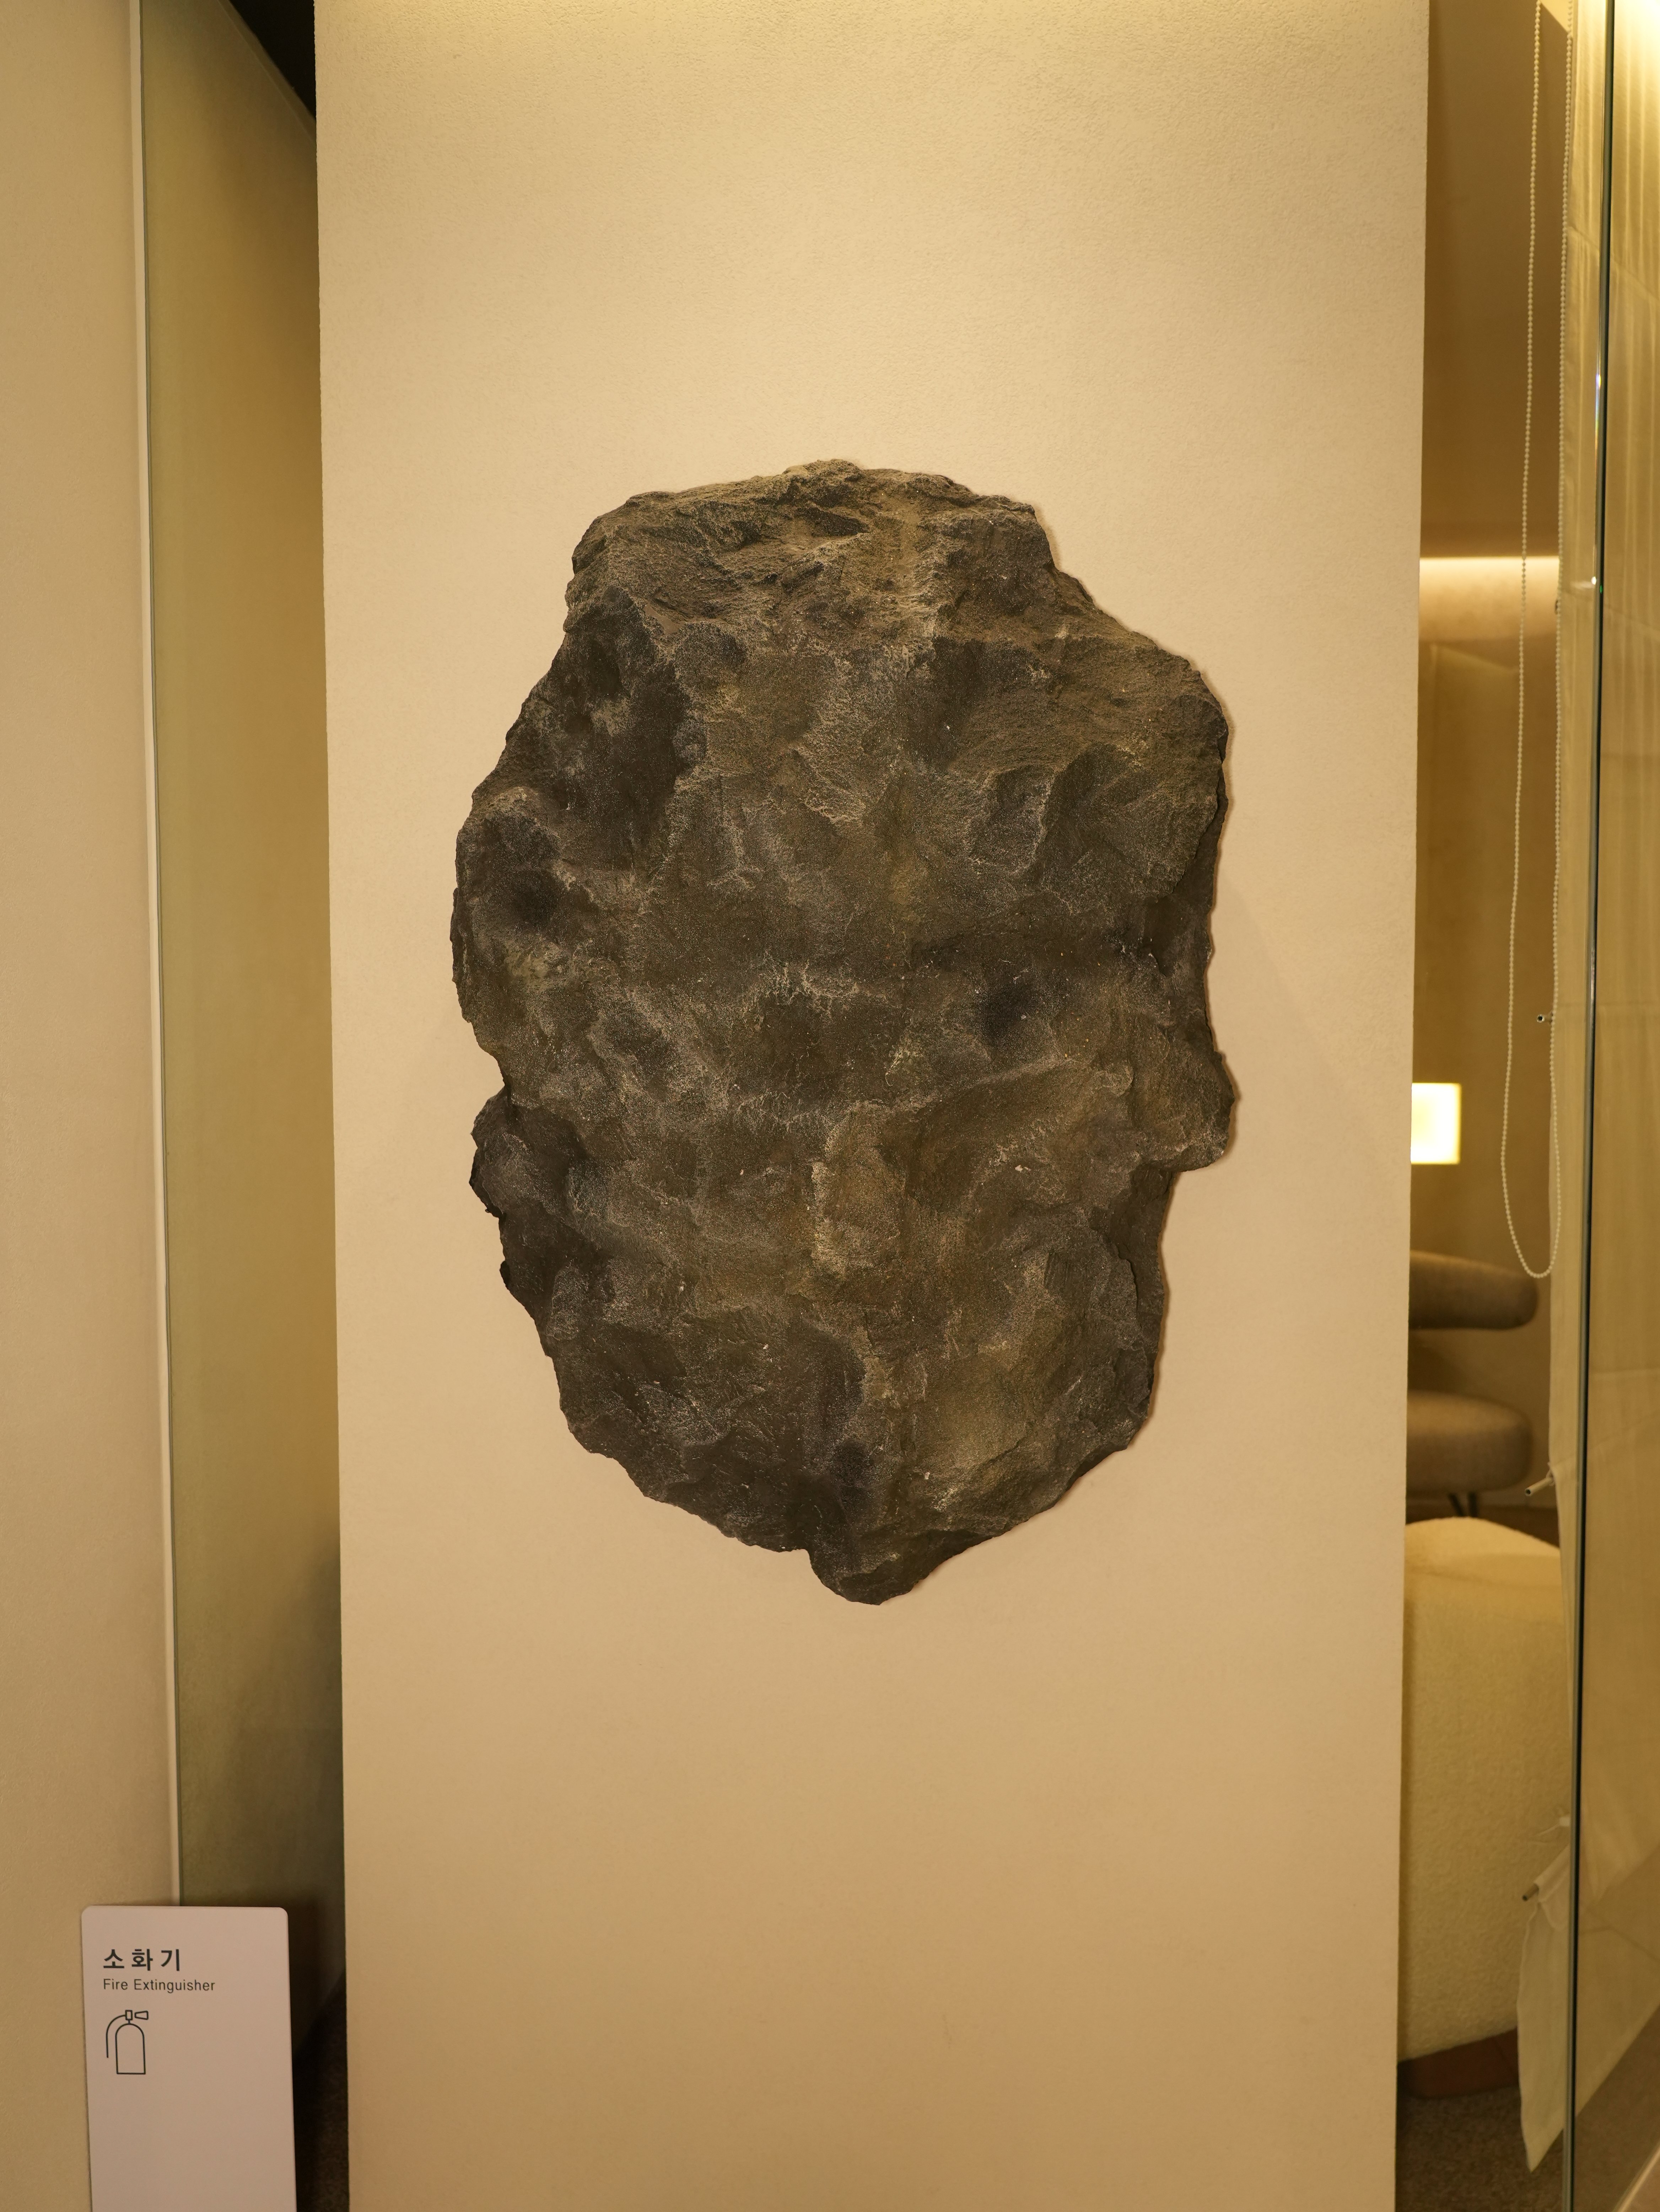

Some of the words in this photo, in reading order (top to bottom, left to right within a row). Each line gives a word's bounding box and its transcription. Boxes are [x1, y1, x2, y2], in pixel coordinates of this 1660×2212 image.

[103, 1948, 180, 1972] 소화기
[103, 1979, 128, 1990] Fire
[134, 1979, 215, 1994] Extinguisher
